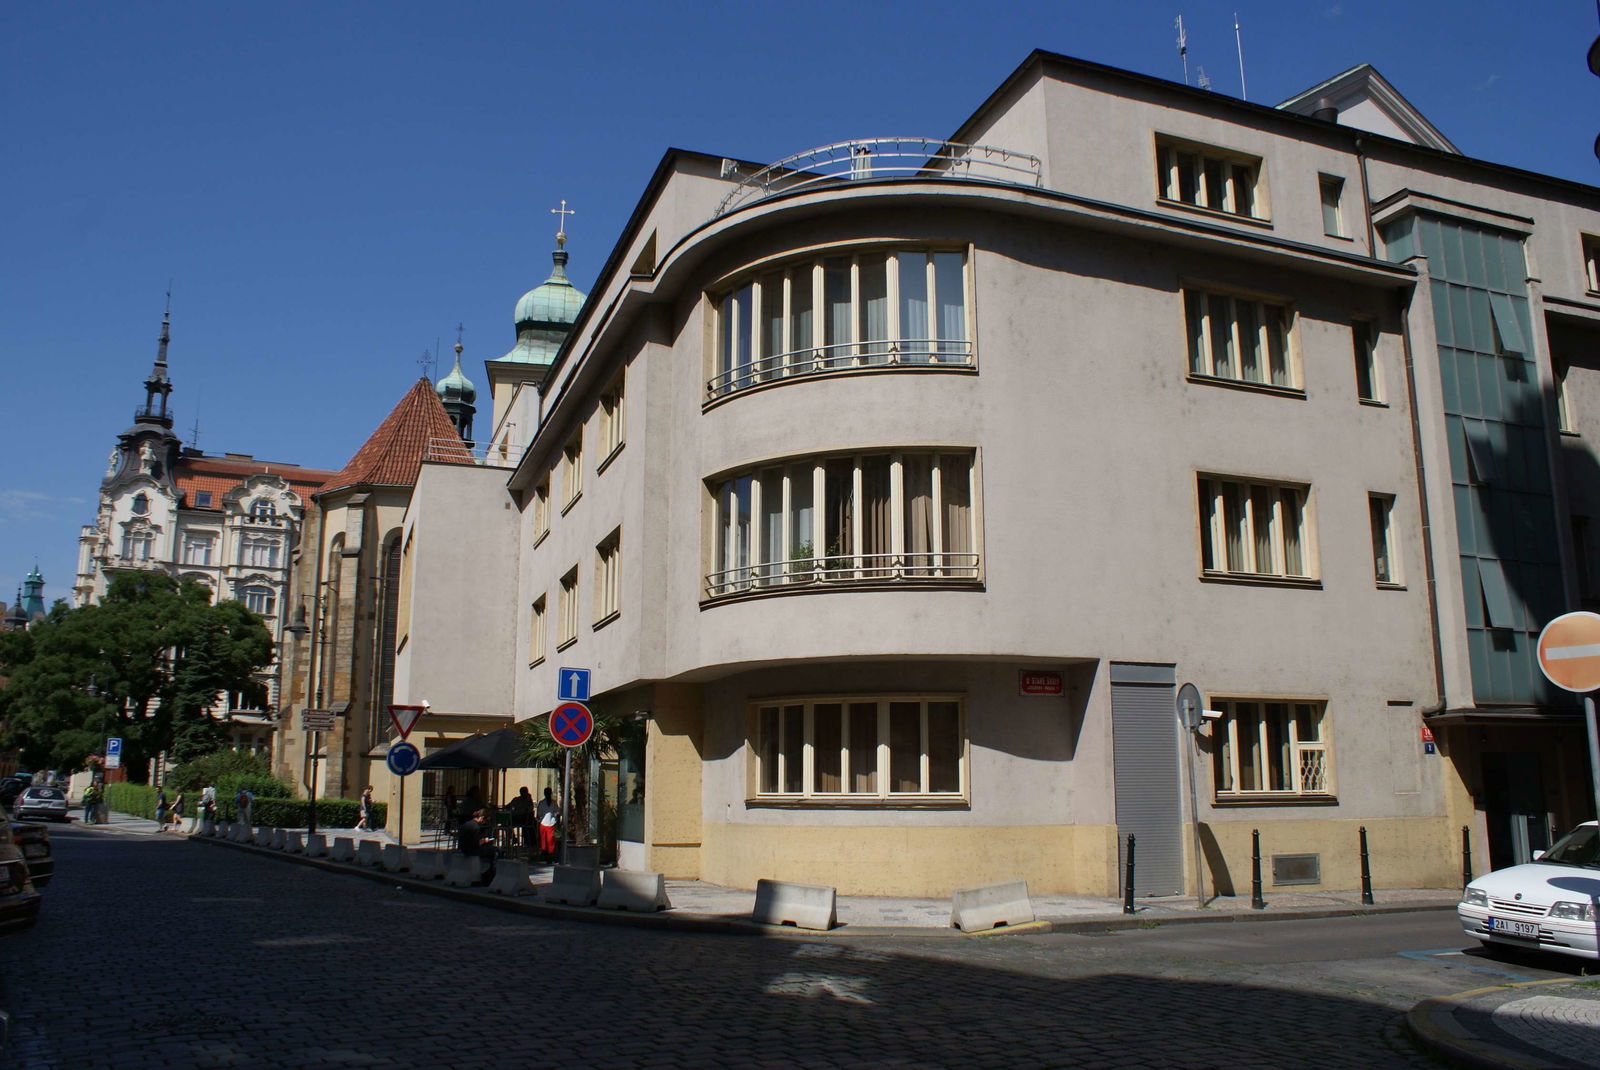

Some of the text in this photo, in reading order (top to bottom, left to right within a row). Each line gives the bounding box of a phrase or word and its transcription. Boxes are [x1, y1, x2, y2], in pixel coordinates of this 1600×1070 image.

[110, 740, 118, 750] P
[1495, 920, 1535, 933] 2AI 9197
